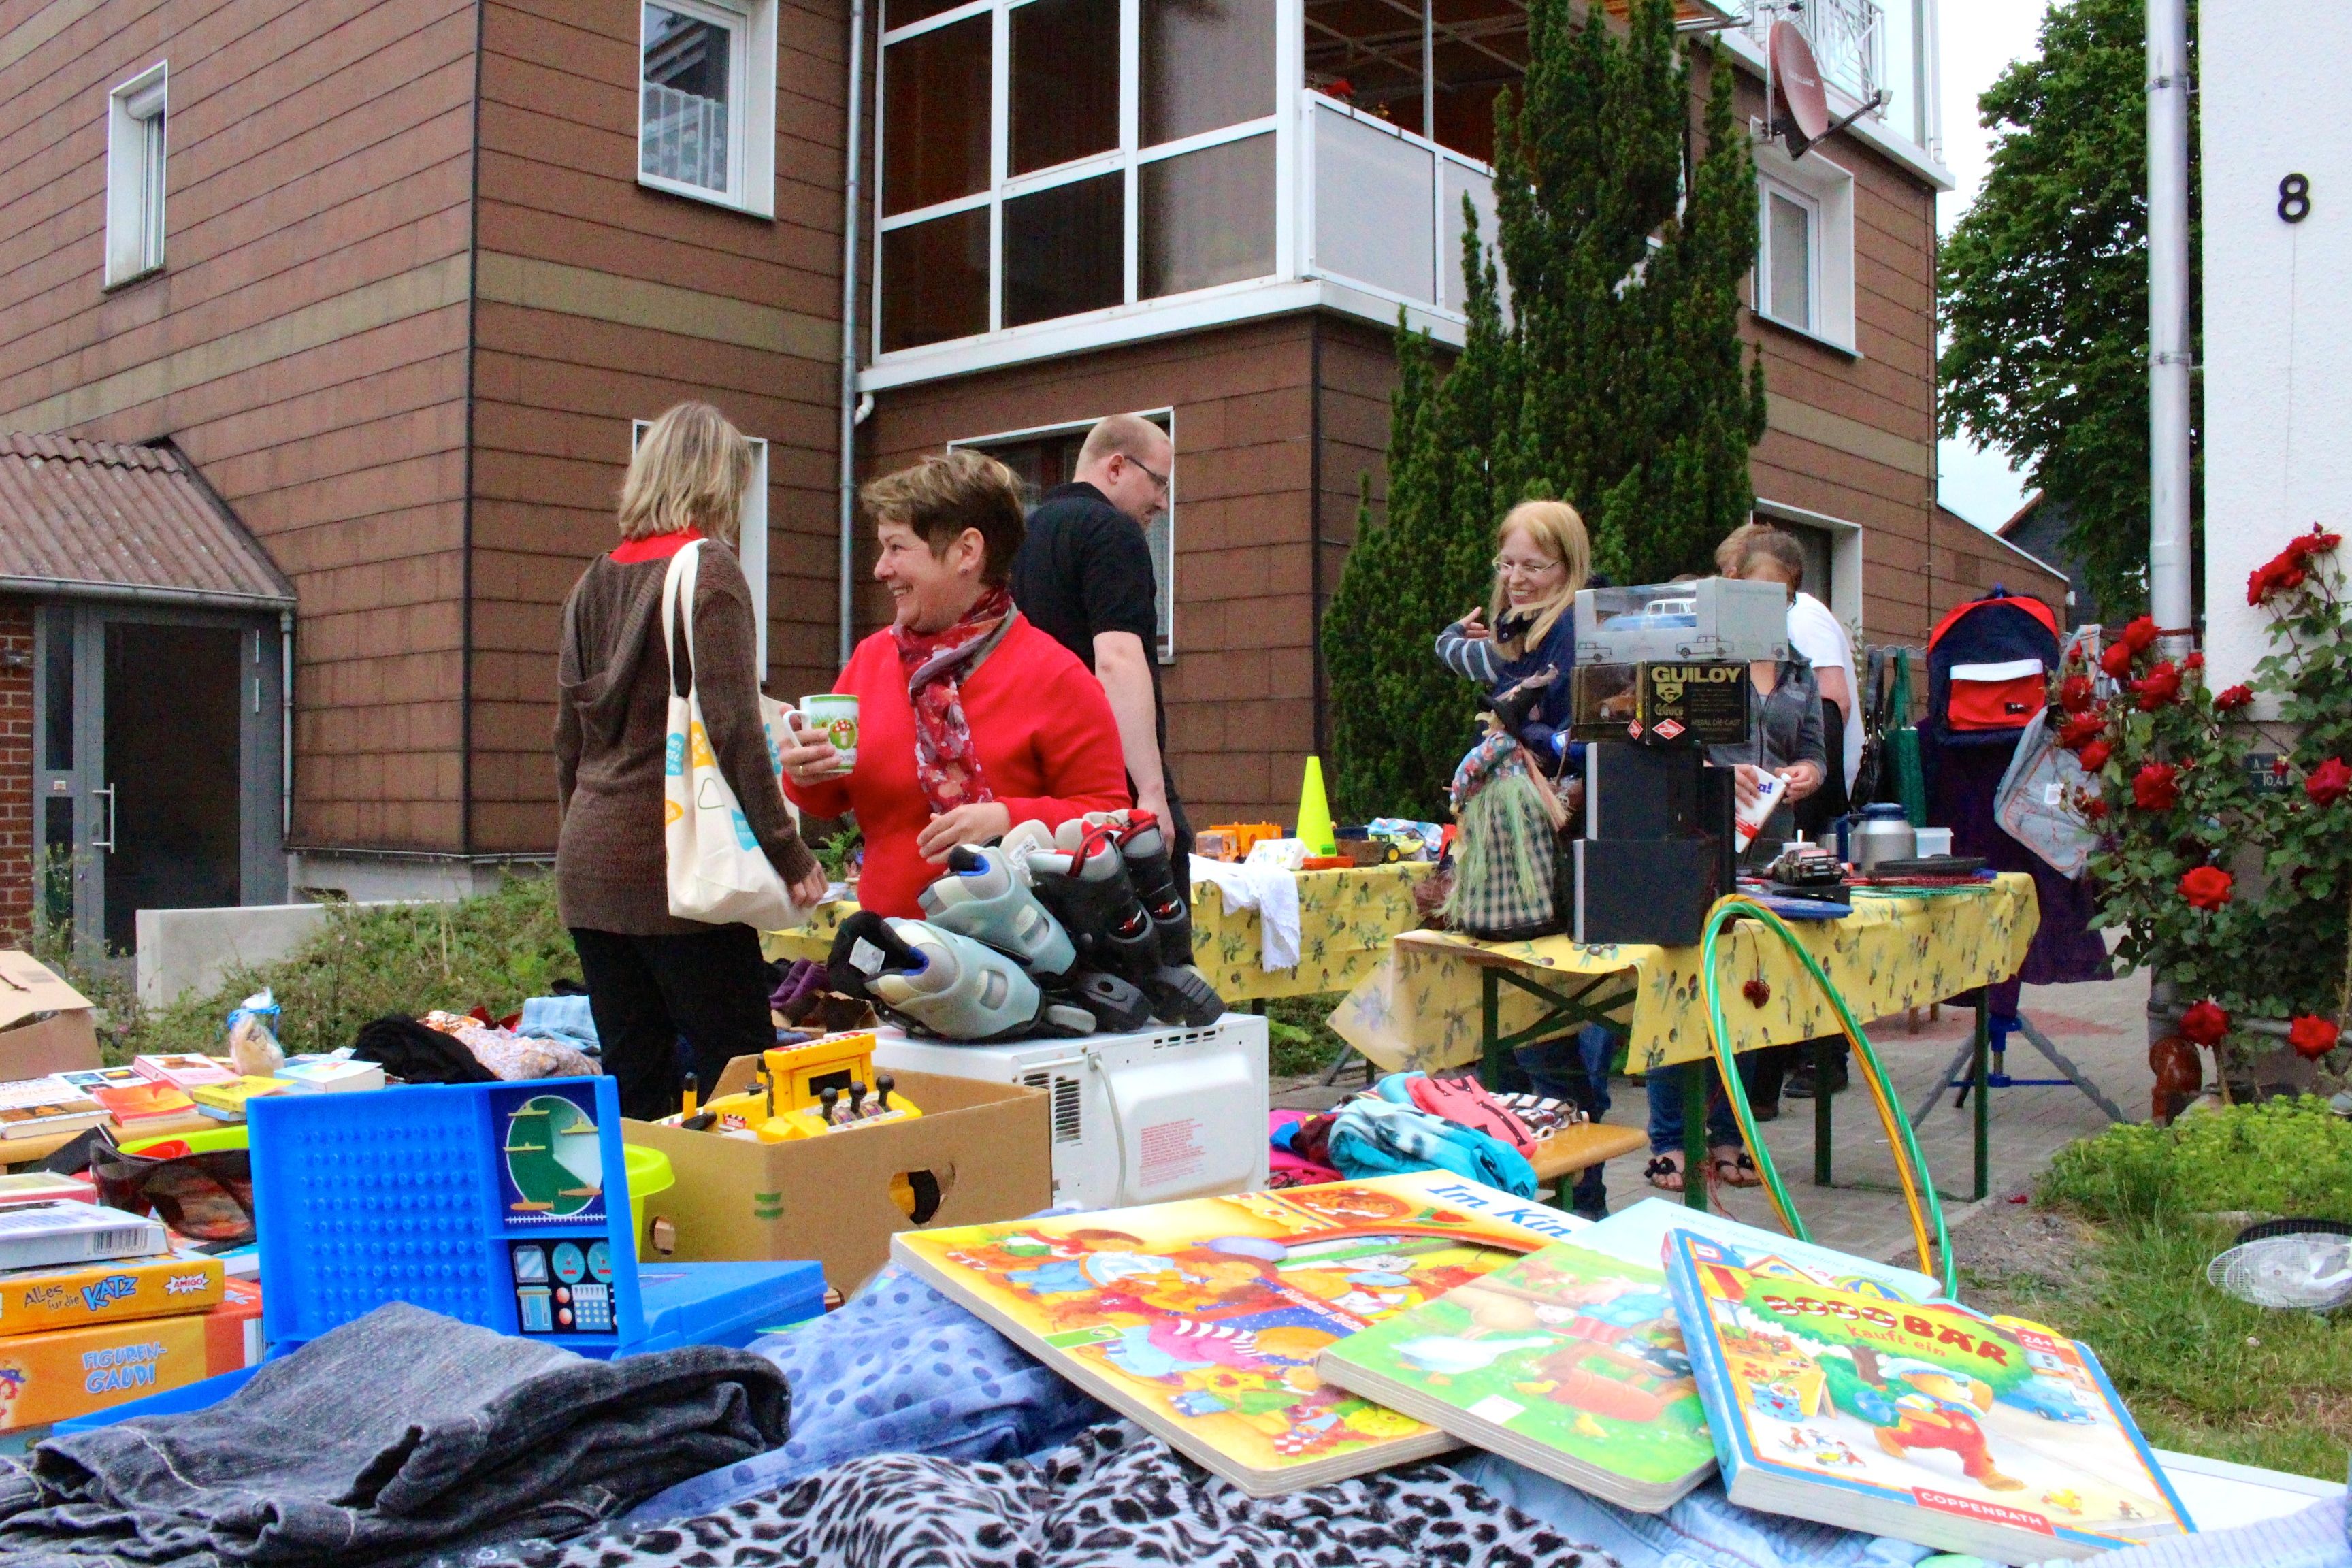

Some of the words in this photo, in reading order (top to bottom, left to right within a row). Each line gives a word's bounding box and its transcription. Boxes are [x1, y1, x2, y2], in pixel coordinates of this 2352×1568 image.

[2278, 173, 2310, 223] 8
[1652, 666, 1741, 683] GUILOY
[1426, 1184, 1489, 1209] Im
[174, 1278, 203, 1288] AMIGO
[1849, 1265, 1894, 1283] Georg
[65, 1294, 80, 1307] die
[80, 1275, 138, 1311] KATZ
[1762, 1295, 1897, 1328] BODO
[1903, 1314, 2008, 1367] BÄR
[2021, 1334, 2053, 1346] 24+
[82, 1341, 168, 1370] FIGUREN-
[1914, 1342, 1946, 1357] ein
[86, 1363, 156, 1394] GAUDI
[1921, 1491, 2042, 1526] COPPENRATH
